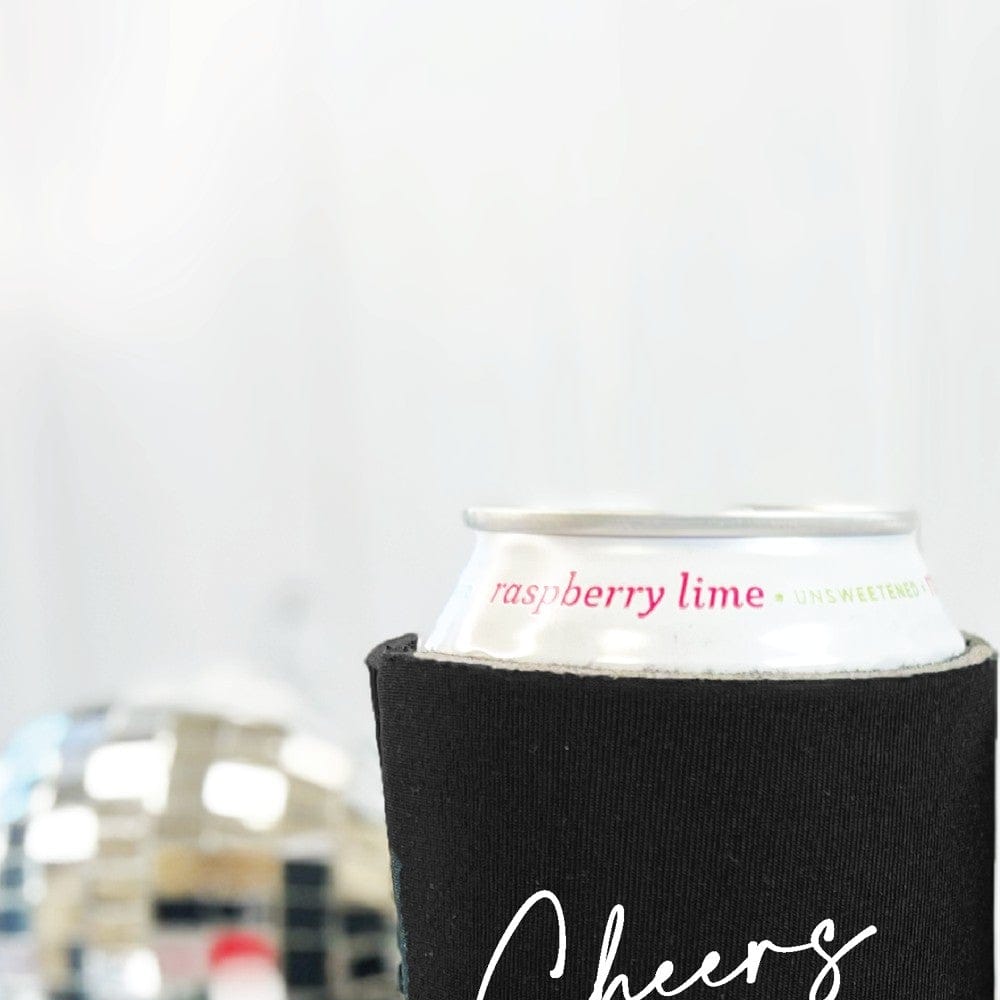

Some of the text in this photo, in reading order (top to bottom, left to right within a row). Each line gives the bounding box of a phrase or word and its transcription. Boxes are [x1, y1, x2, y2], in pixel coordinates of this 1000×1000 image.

[489, 570, 666, 620] raspberry
[677, 570, 765, 610] lime
[793, 579, 920, 605] UNSWEETENED
